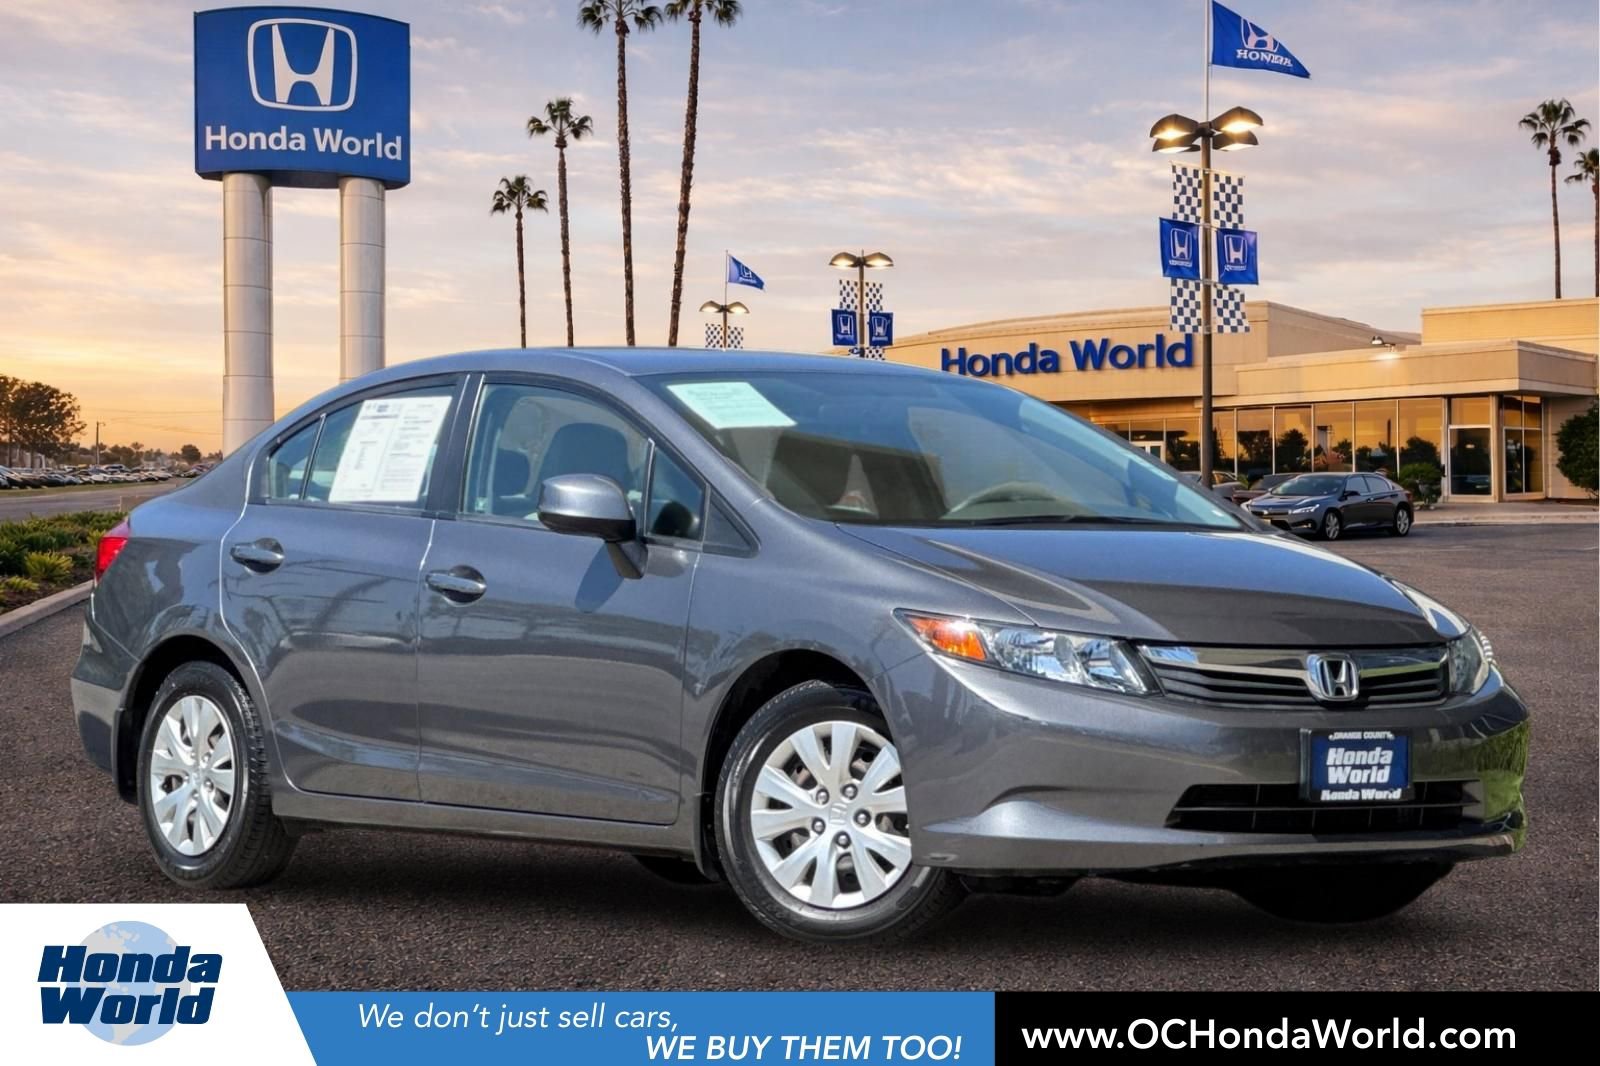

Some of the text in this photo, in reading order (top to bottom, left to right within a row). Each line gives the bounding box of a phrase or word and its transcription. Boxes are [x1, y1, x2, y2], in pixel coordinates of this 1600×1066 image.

[204, 125, 402, 161] Honda World
[940, 333, 1195, 377] Honda World
[1326, 746, 1394, 766] Honda
[1327, 765, 1391, 784] World
